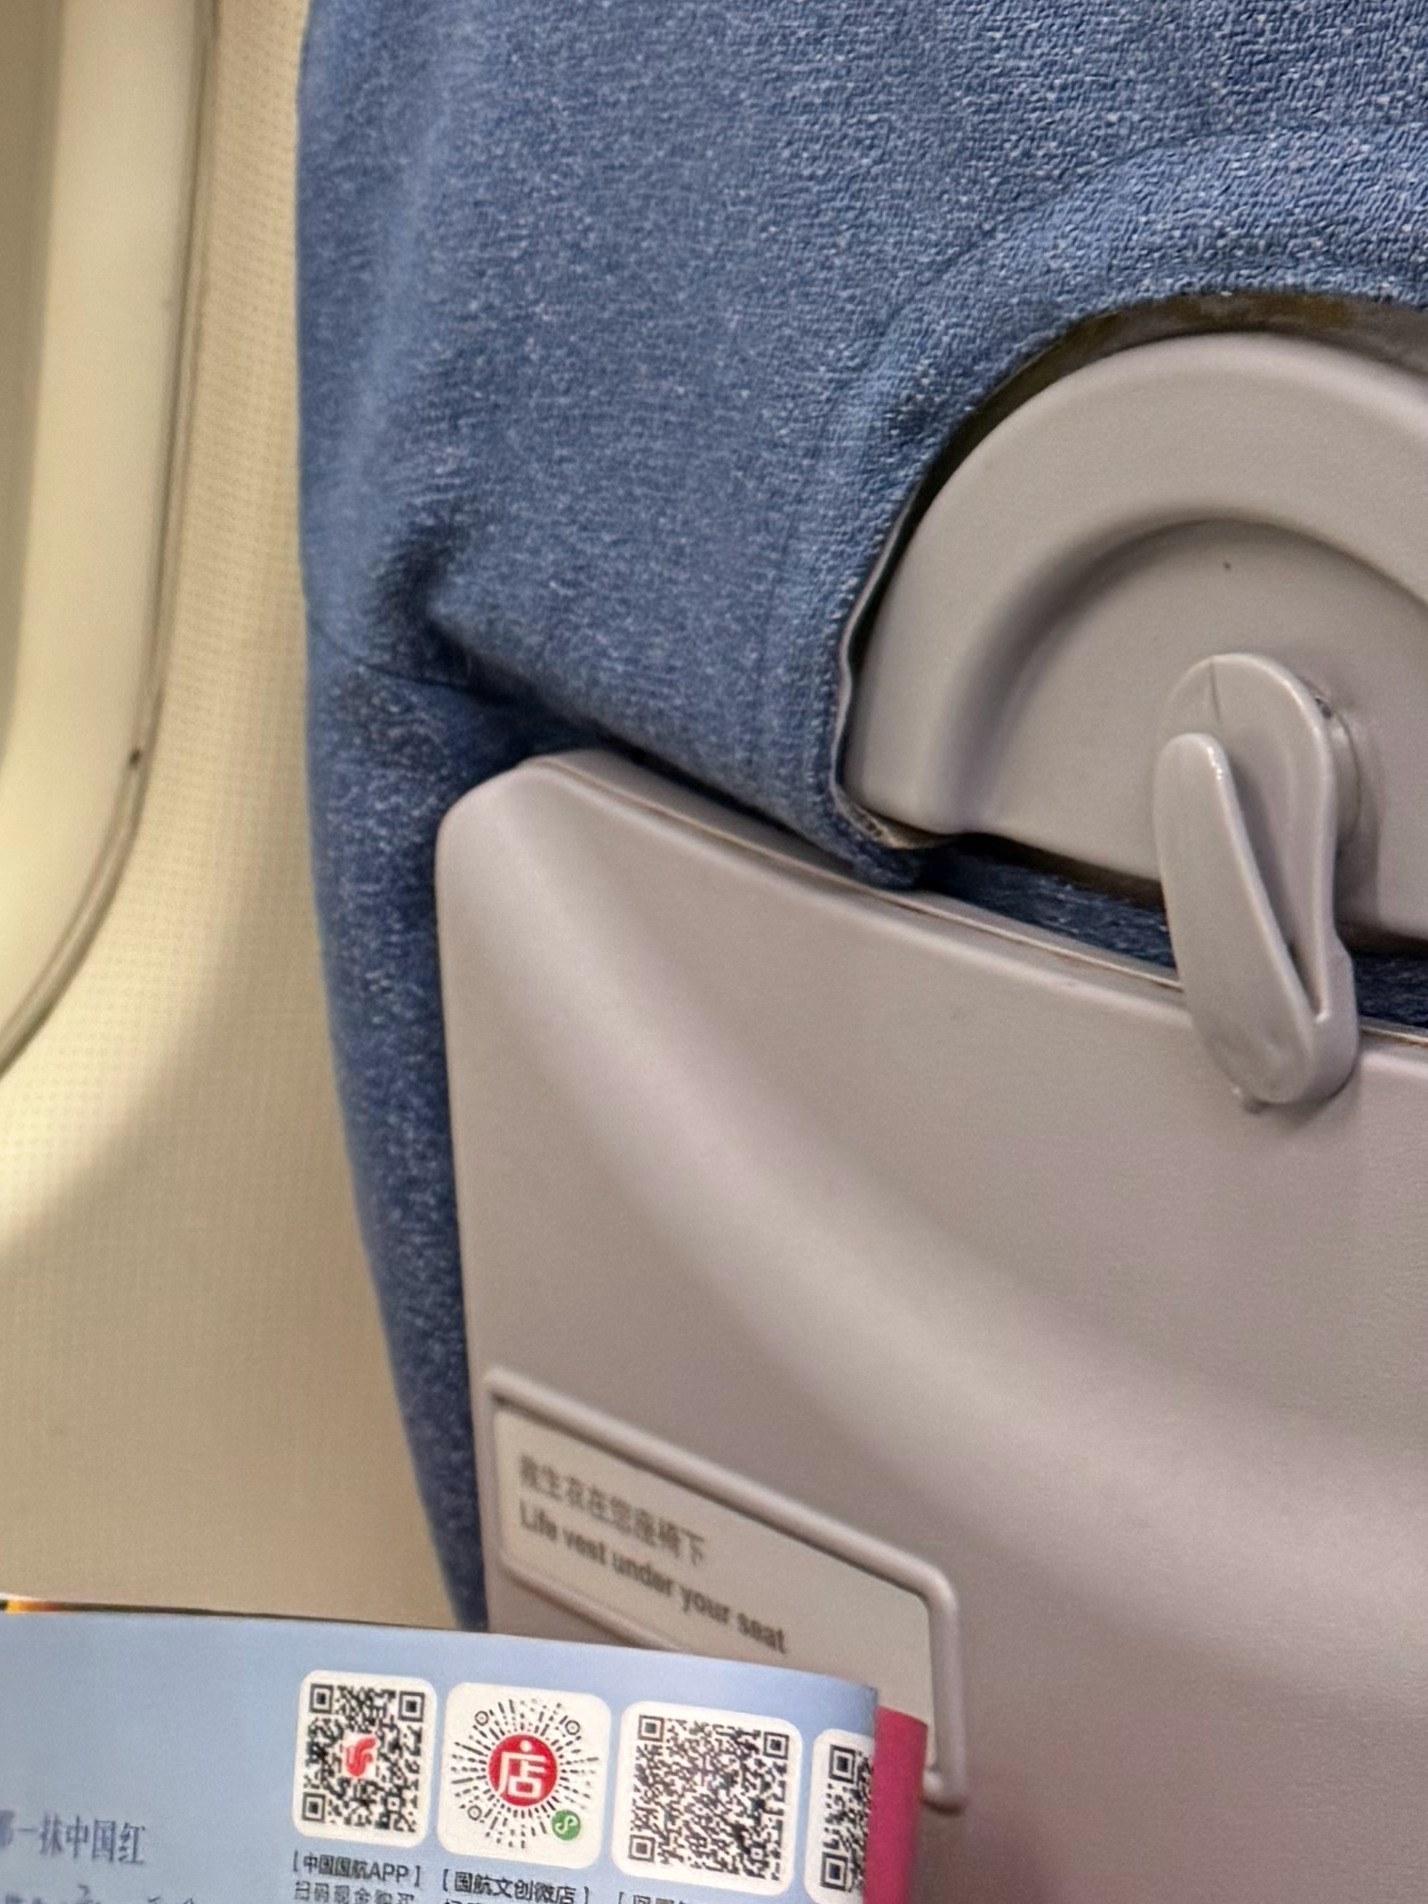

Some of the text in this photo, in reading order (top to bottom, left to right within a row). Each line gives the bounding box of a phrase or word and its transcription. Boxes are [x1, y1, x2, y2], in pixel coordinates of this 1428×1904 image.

[519, 1497, 786, 1654] Life vest under your seat
